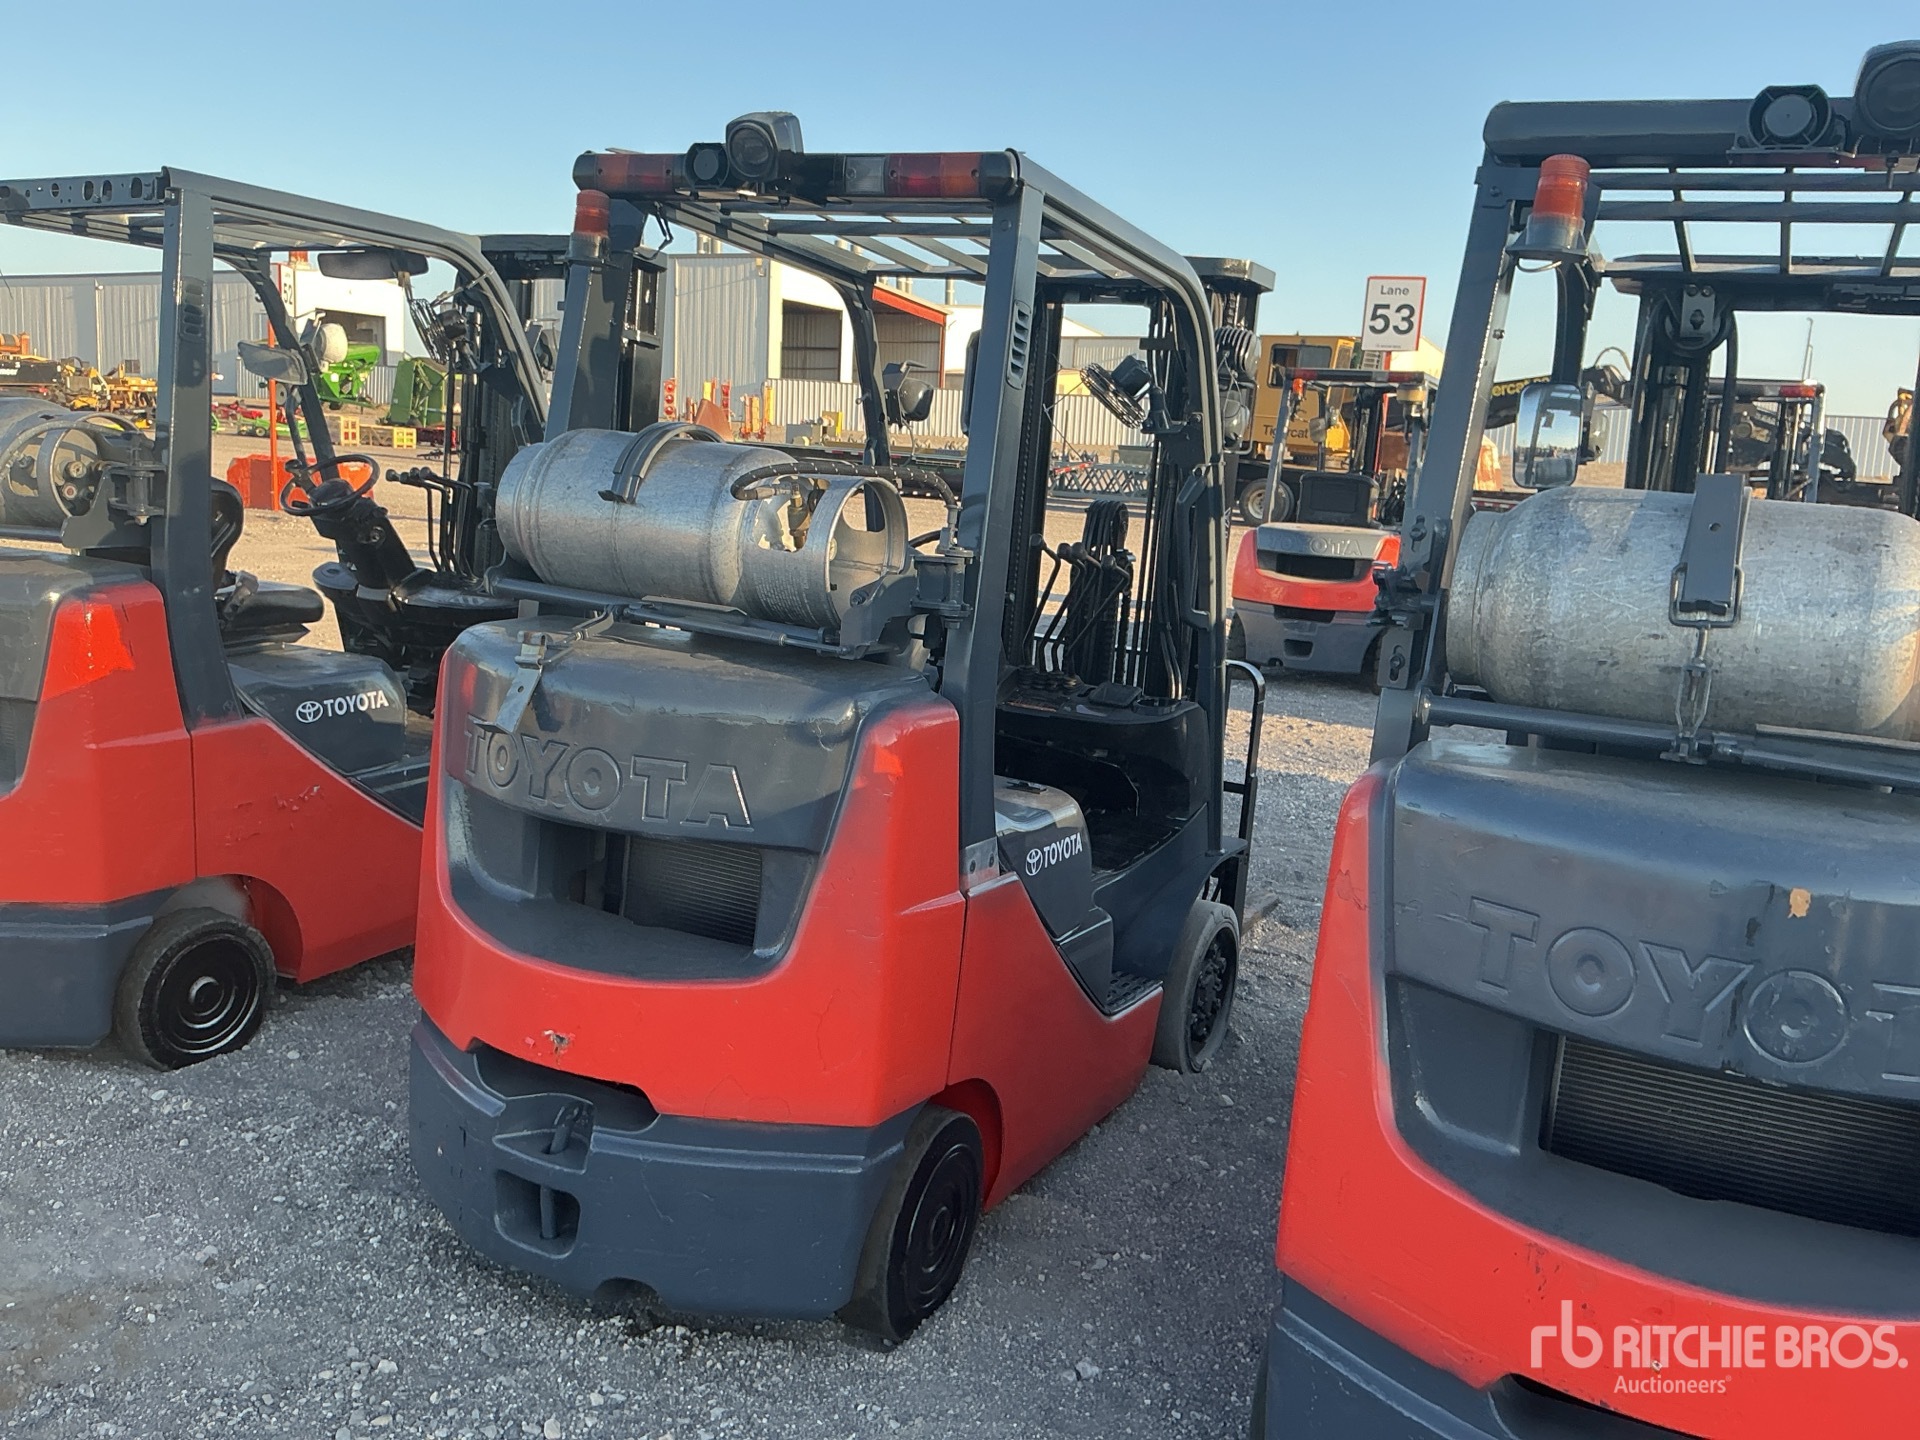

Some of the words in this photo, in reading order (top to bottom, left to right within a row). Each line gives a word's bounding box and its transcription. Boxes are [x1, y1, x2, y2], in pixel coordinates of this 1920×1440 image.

[283, 282, 293, 305] 52
[1380, 284, 1410, 296] Lane
[1368, 303, 1416, 335] 53
[1263, 424, 1309, 439] Tigrcat
[323, 690, 389, 717] TOYOTA
[463, 728, 754, 832] TOYOTA
[1043, 832, 1083, 868] TOYOTA
